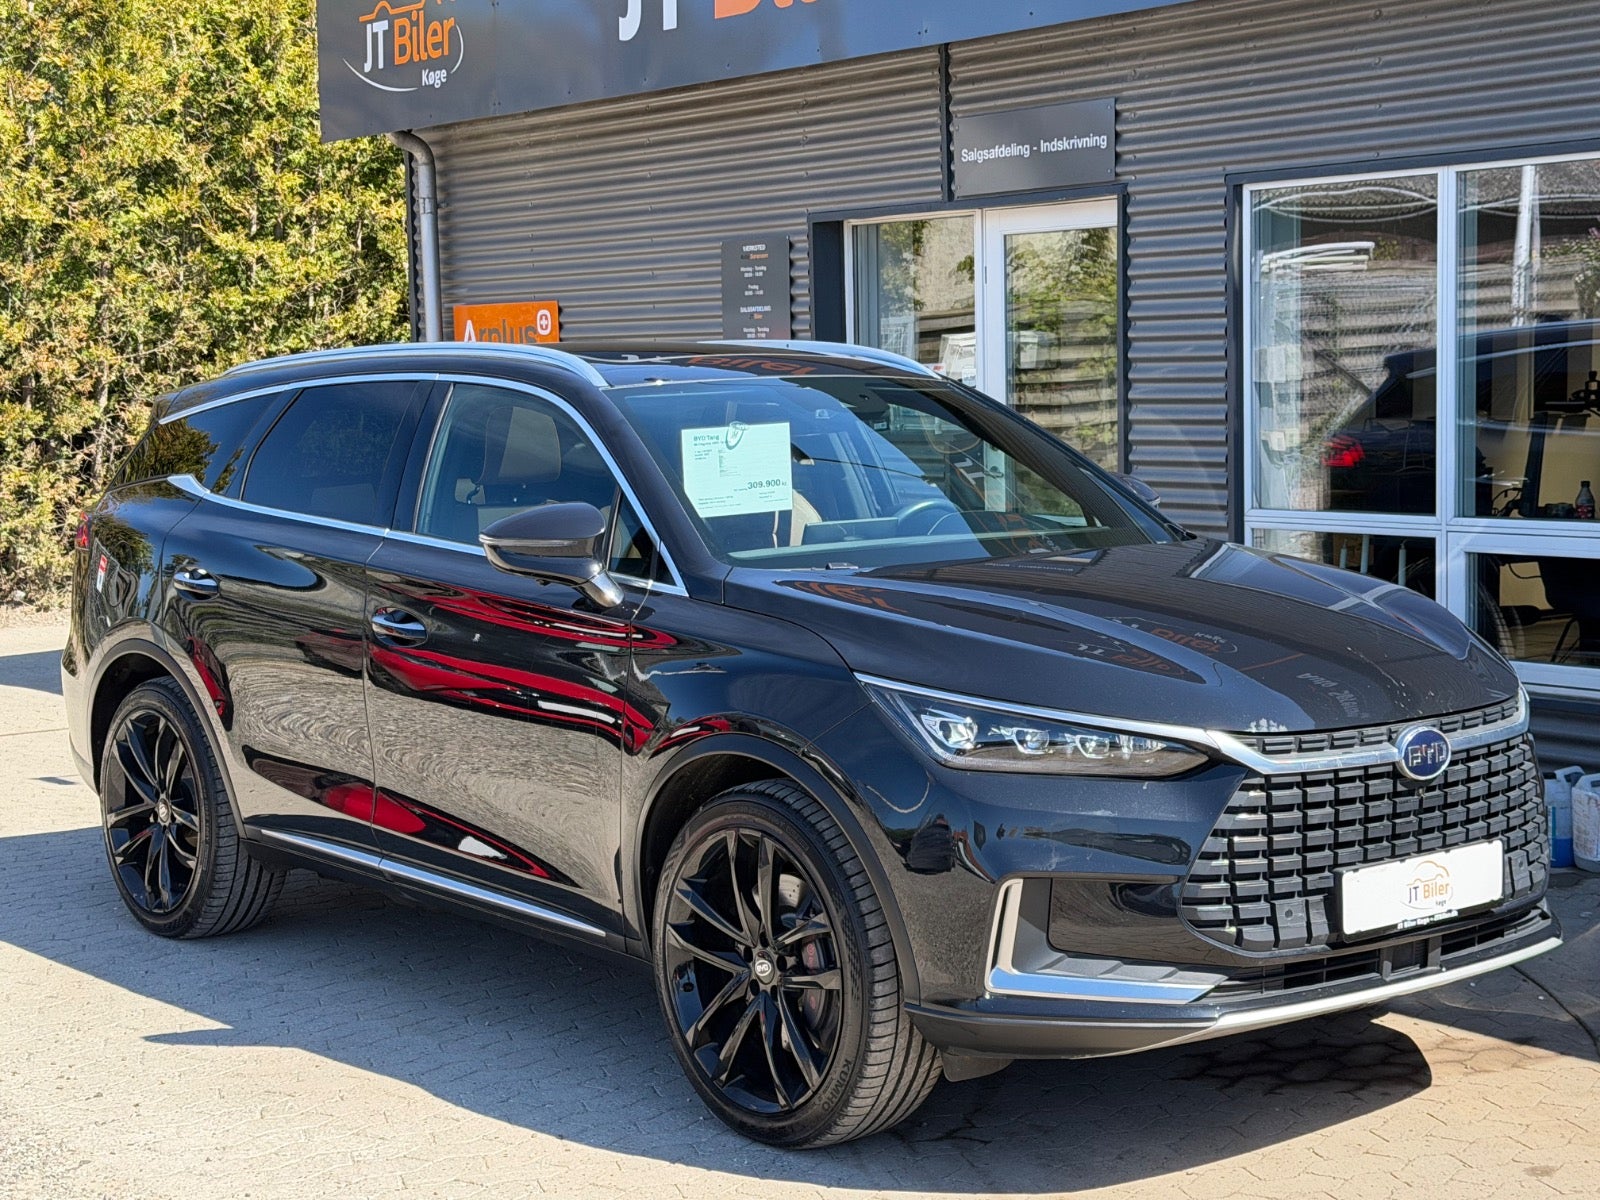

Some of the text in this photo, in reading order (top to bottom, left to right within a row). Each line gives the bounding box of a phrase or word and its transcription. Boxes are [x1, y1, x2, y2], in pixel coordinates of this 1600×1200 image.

[363, 9, 455, 73] JT Biler
[421, 68, 447, 88] Køge
[961, 143, 1031, 164] Salgsafdeling
[1040, 133, 1108, 153] Indskrivning
[747, 478, 781, 490] 309.900
[1407, 741, 1447, 767] BYD
[1408, 881, 1449, 904] JT Biler
[821, 1058, 853, 1111] KUMHO
